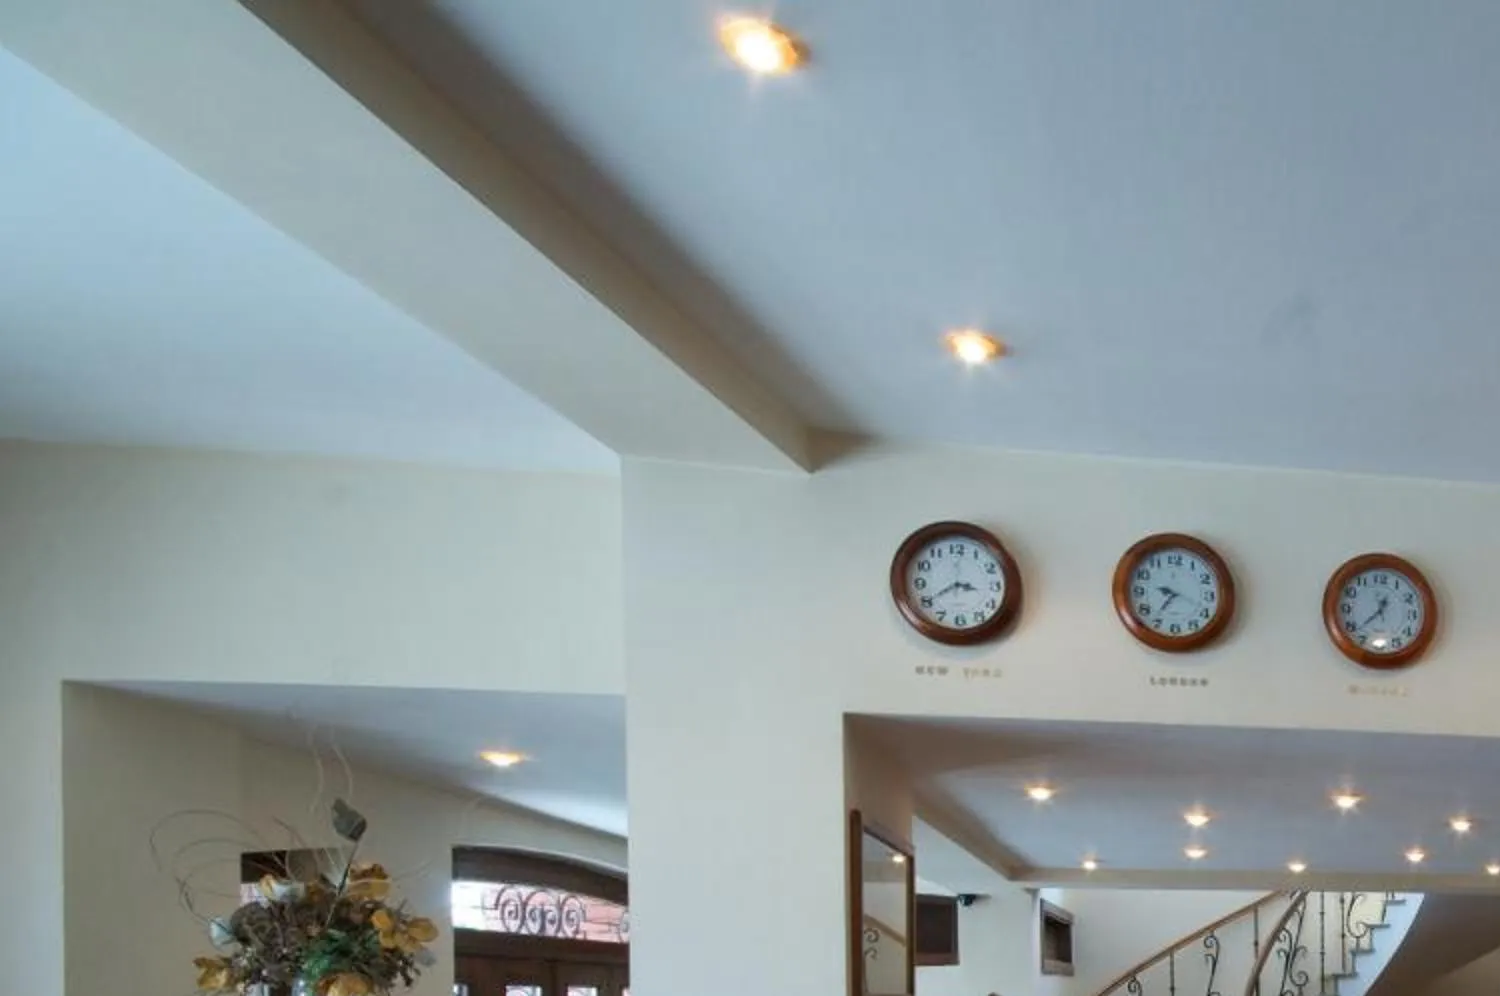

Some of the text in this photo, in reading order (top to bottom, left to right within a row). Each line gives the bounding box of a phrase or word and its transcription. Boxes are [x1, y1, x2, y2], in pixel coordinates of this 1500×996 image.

[930, 548, 942, 559] 11
[950, 543, 965, 556] 12
[917, 560, 931, 572] 10
[984, 562, 997, 574] 2
[914, 577, 927, 590] 9
[990, 581, 1001, 592] 3
[920, 595, 933, 608] 8
[985, 598, 996, 610] 4
[936, 611, 947, 622] 7
[954, 614, 967, 626] 6
[973, 611, 985, 623] 5
